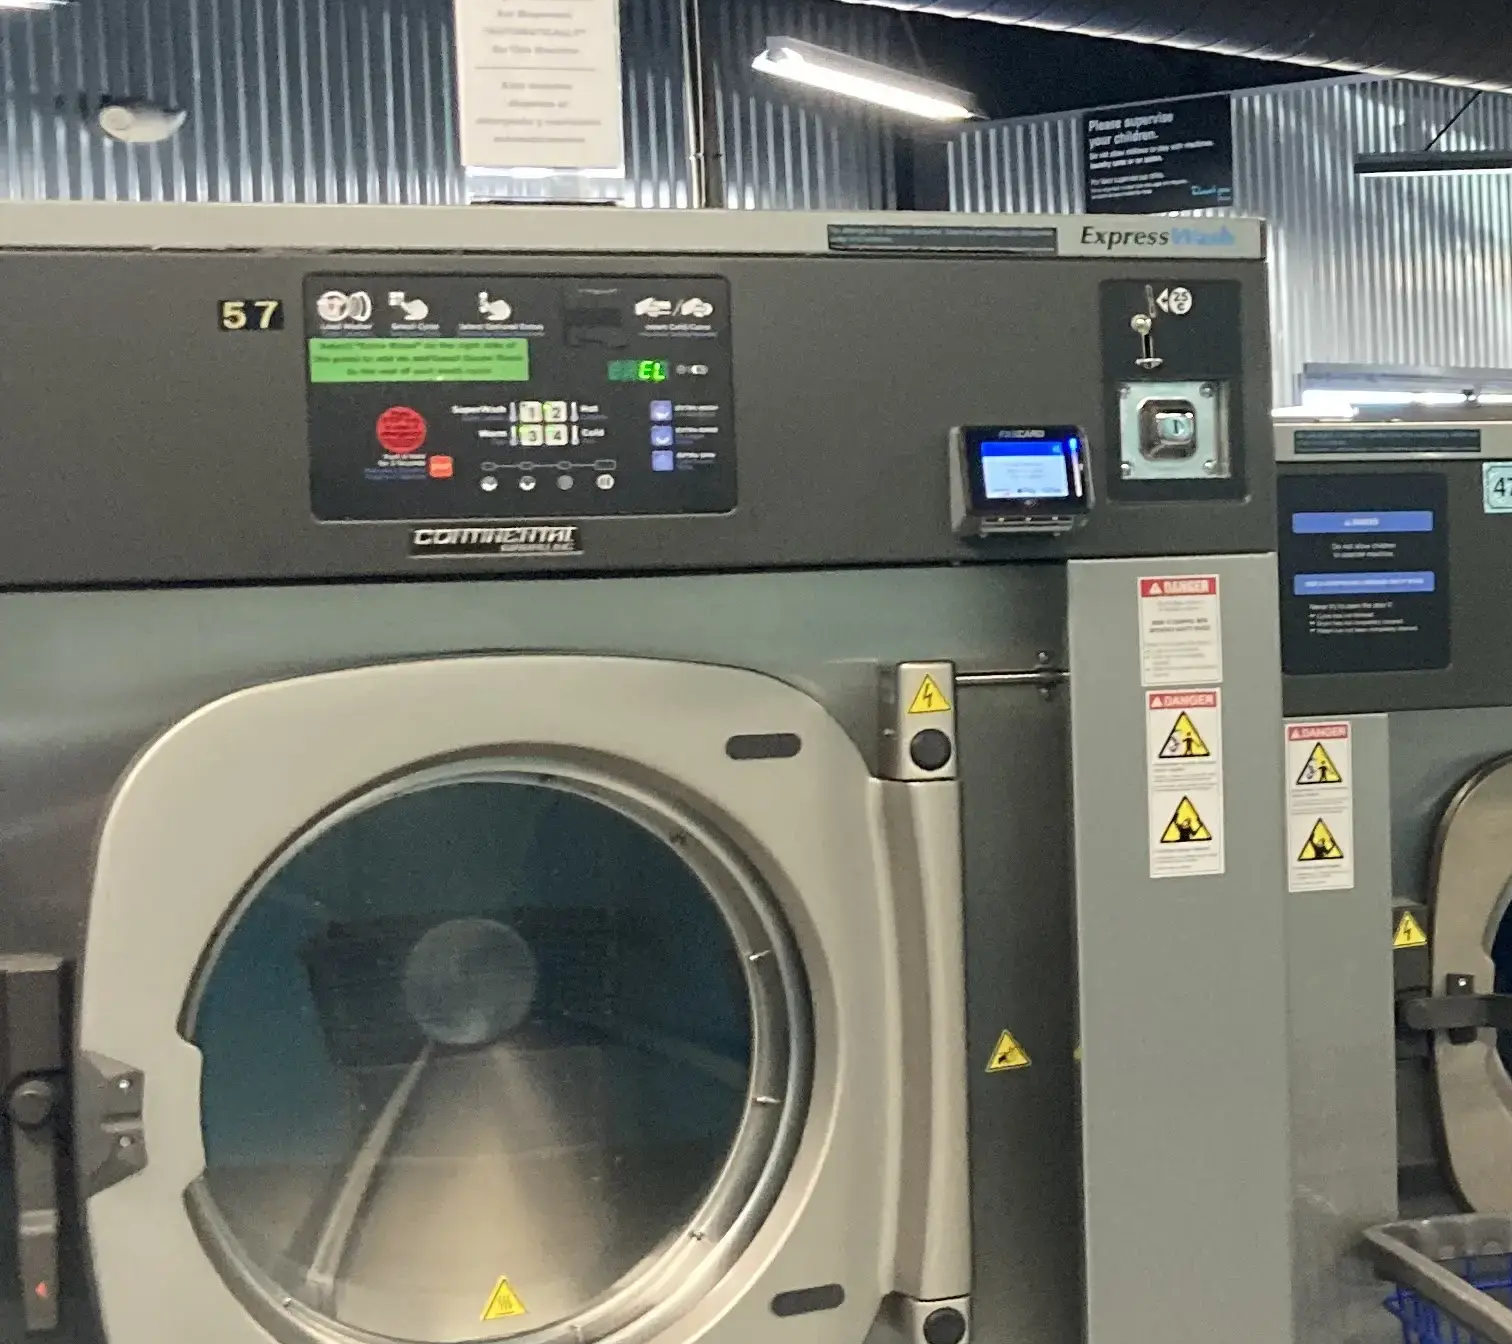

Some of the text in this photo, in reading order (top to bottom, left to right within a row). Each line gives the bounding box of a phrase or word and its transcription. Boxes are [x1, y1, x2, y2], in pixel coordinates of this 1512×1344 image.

[1088, 112, 1175, 132] Please supervise
[1088, 136, 1112, 150] your
[221, 301, 279, 330] 57
[1163, 693, 1215, 708] DANGER
[1299, 726, 1347, 739] DANGER
